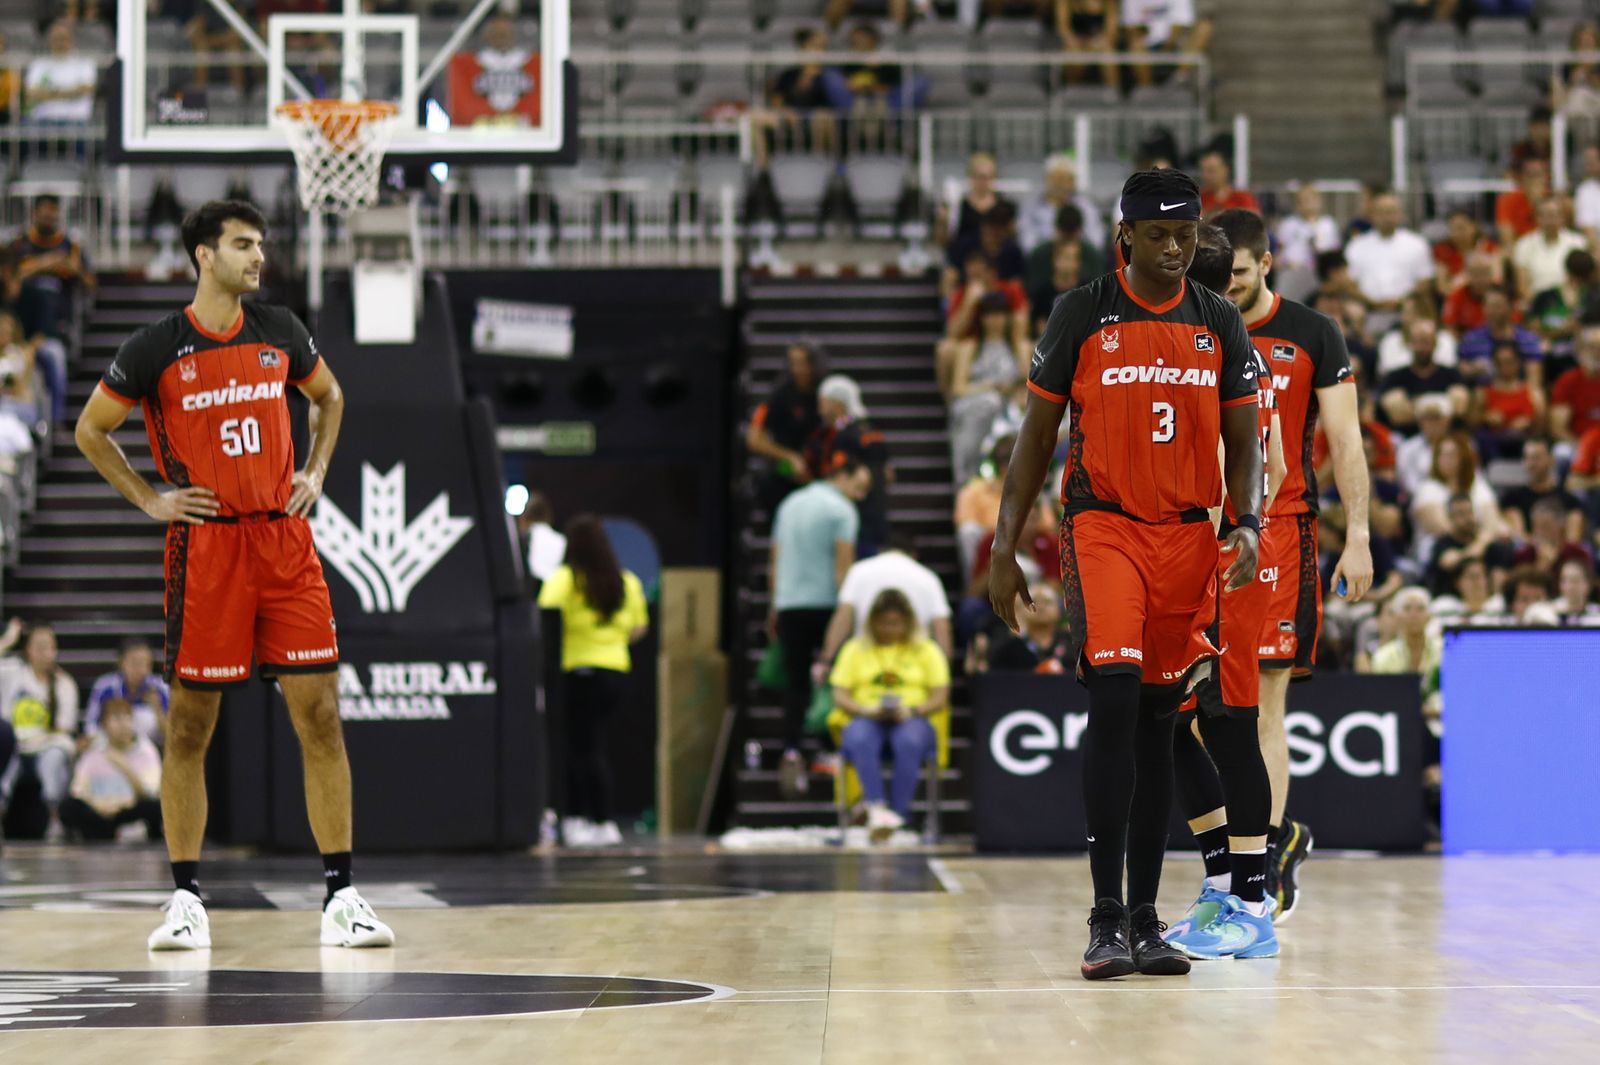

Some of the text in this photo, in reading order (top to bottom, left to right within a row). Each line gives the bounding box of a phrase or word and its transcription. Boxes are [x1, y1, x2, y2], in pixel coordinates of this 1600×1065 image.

[219, 415, 263, 457] 50
[1152, 401, 1176, 443] 3
[1094, 649, 1115, 660] vive
[369, 661, 497, 695] RURAL
